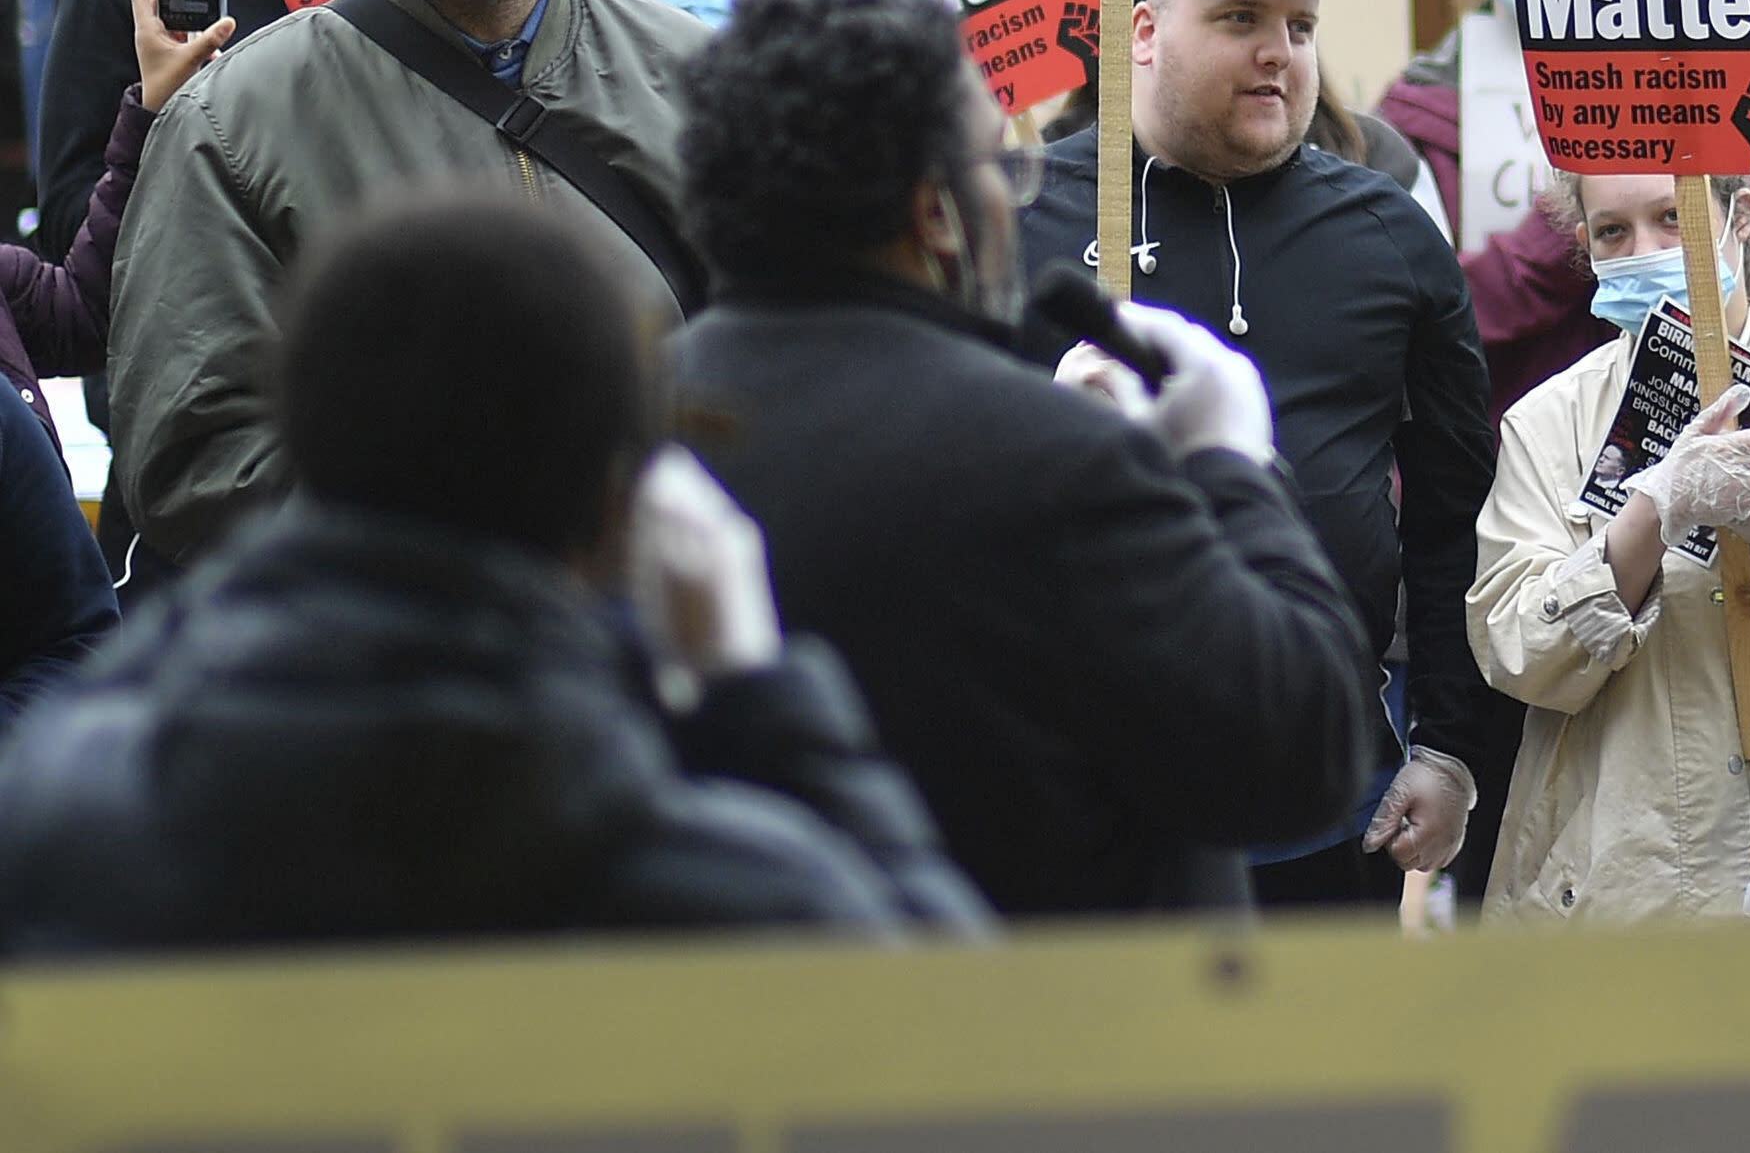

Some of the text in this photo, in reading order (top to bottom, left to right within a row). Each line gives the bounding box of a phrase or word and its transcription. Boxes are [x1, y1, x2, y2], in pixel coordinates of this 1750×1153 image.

[967, 4, 1046, 55] racism
[1535, 60, 1727, 90] Smash racism
[1541, 95, 1721, 129] by any means
[1548, 135, 1676, 163] necessary
[1629, 379, 1689, 420] KINGSLEY
[1648, 375, 1676, 398] JOIN
[1632, 397, 1684, 433] BRUTALI
